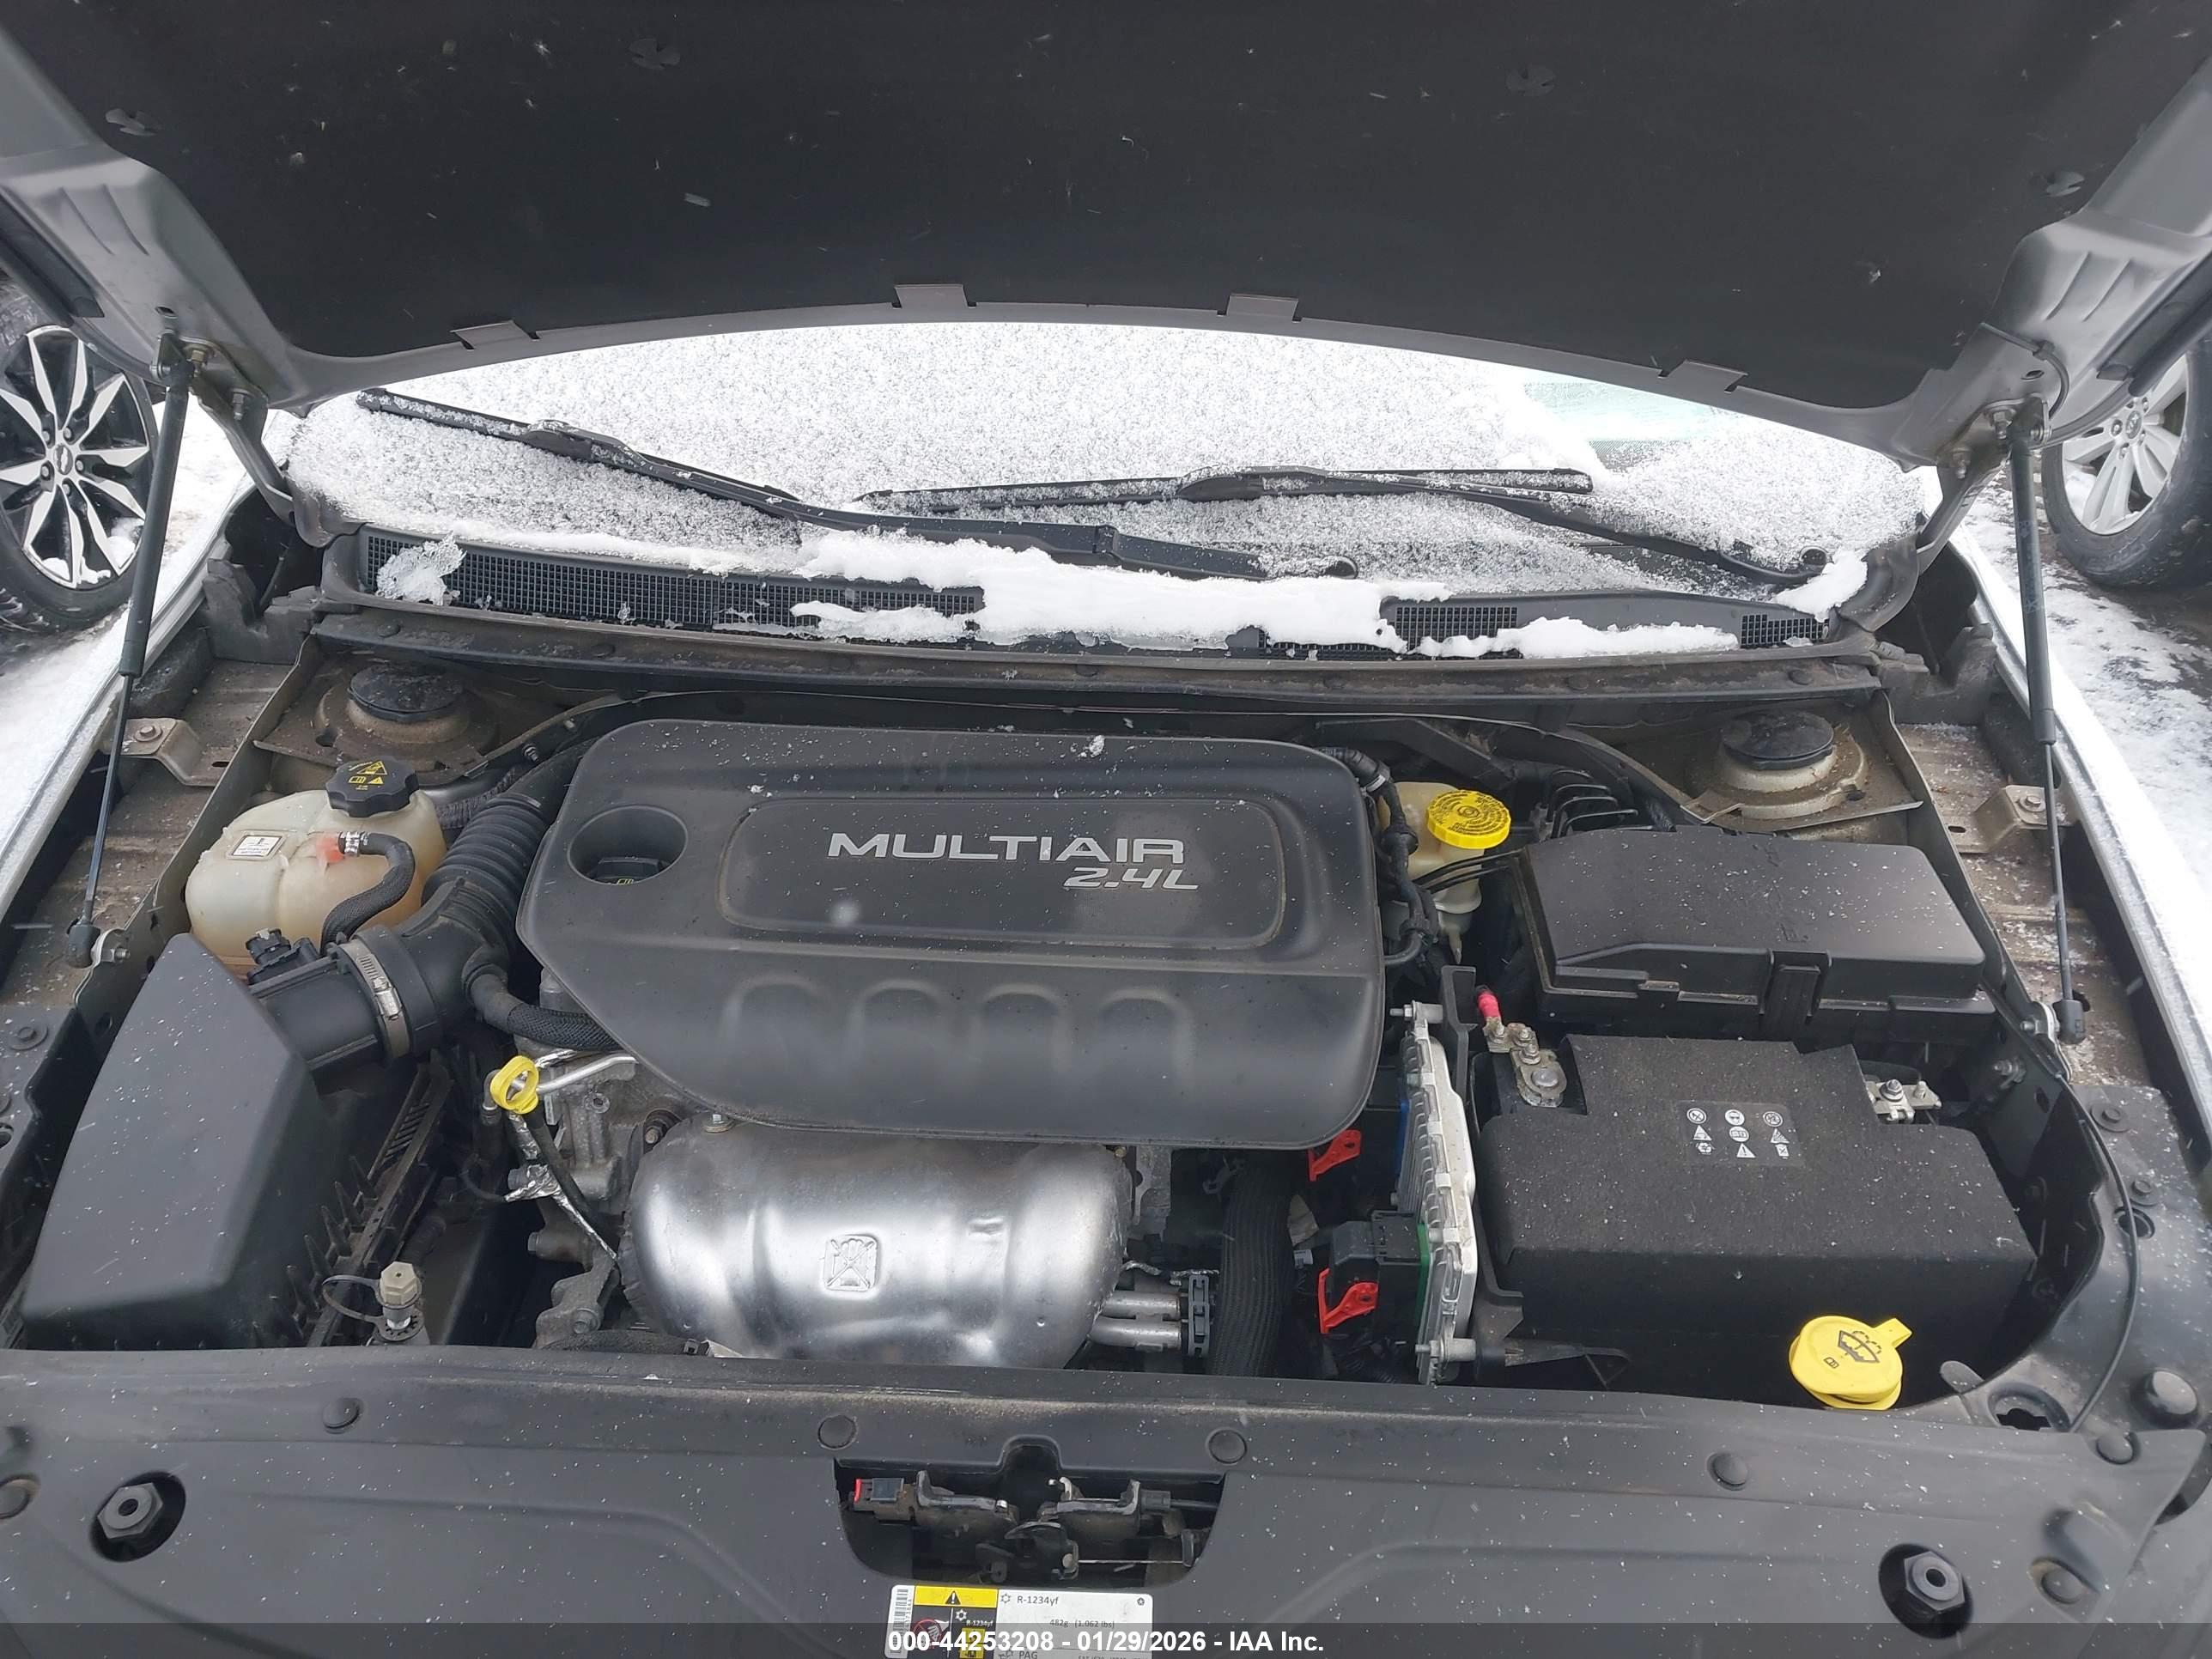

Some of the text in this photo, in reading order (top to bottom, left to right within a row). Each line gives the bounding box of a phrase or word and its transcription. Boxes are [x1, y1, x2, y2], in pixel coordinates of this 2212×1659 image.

[827, 831, 1184, 864] MULTIAIR
[1063, 866, 1199, 890] 2.4L
[1017, 1595, 1059, 1607] R-1234yf
[1049, 1620, 1069, 1628] 482g
[1018, 1650, 1038, 1659] PAG
